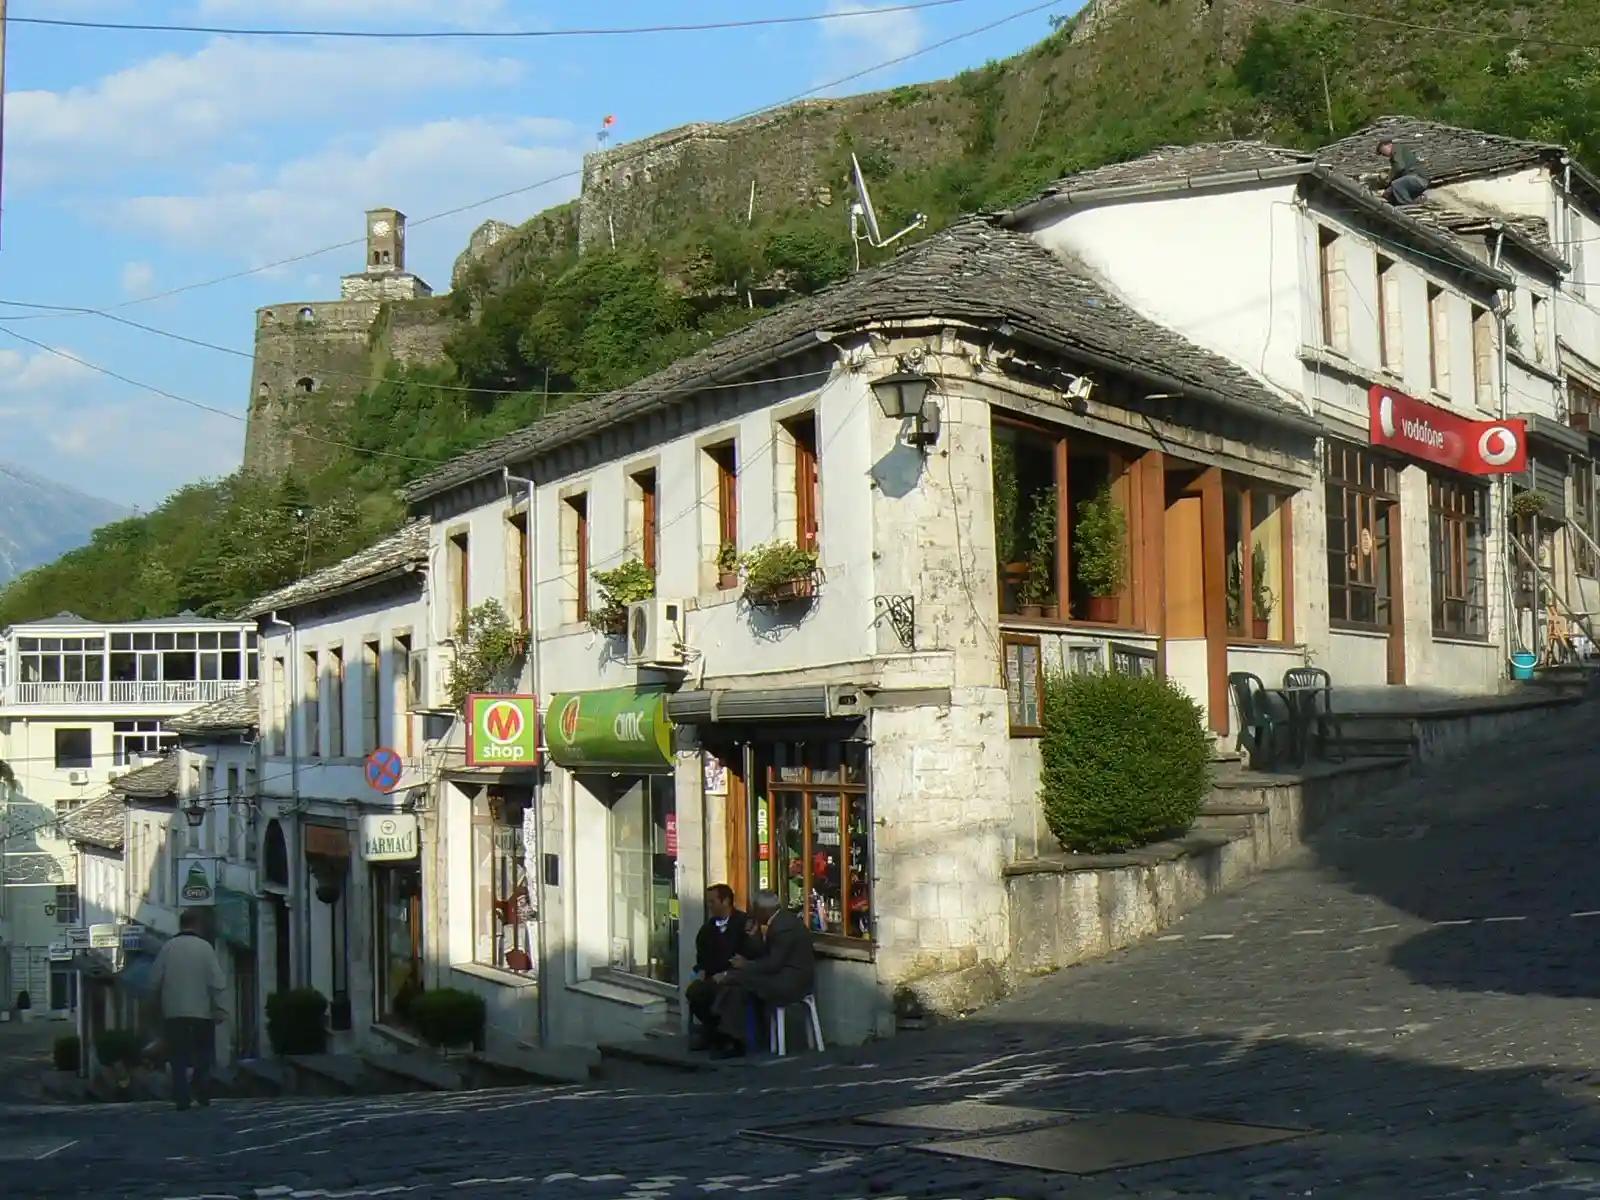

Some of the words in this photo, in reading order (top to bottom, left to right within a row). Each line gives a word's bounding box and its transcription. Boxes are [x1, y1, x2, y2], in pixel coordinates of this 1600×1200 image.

[1401, 418, 1444, 449] vodafone
[487, 707, 521, 741] M
[614, 710, 646, 742] amc
[483, 744, 524, 761] shop
